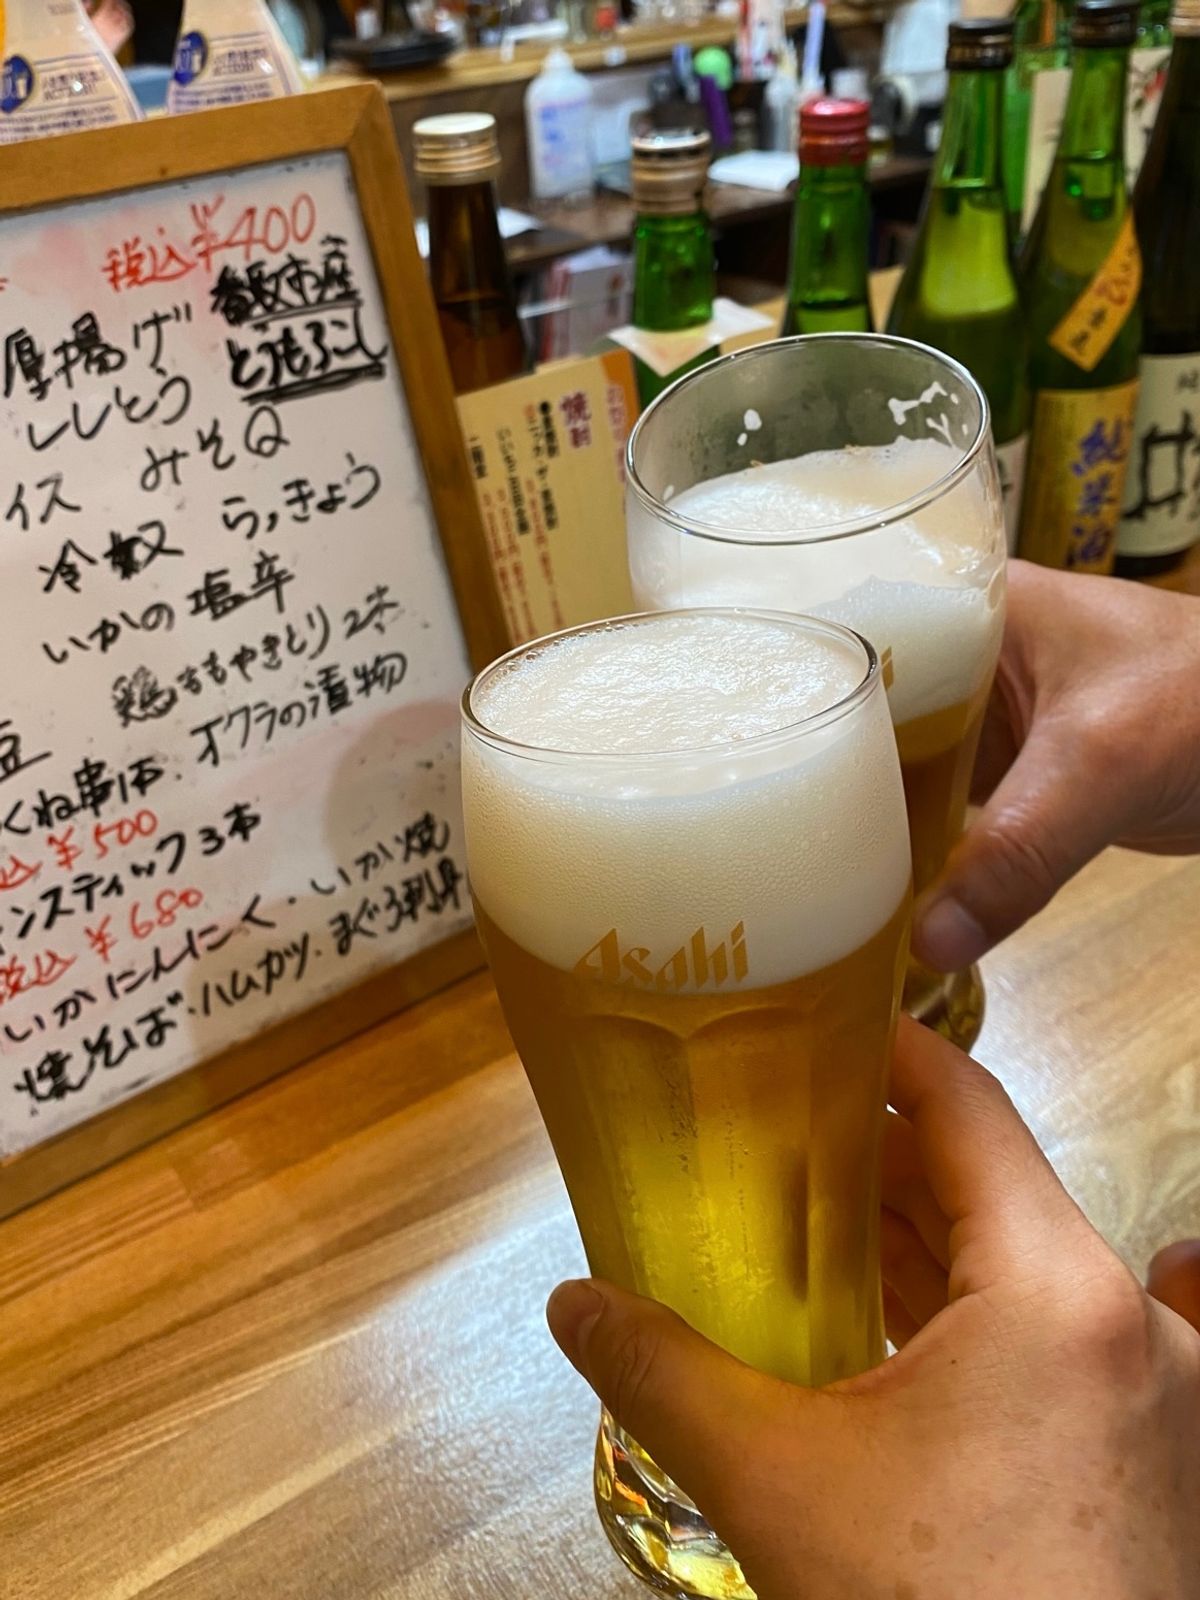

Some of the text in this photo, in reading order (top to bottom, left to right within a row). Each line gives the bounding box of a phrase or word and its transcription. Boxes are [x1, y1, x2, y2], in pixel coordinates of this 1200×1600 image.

[0, 802, 262, 957] ンスティック3本
[573, 920, 749, 990] Asahi
